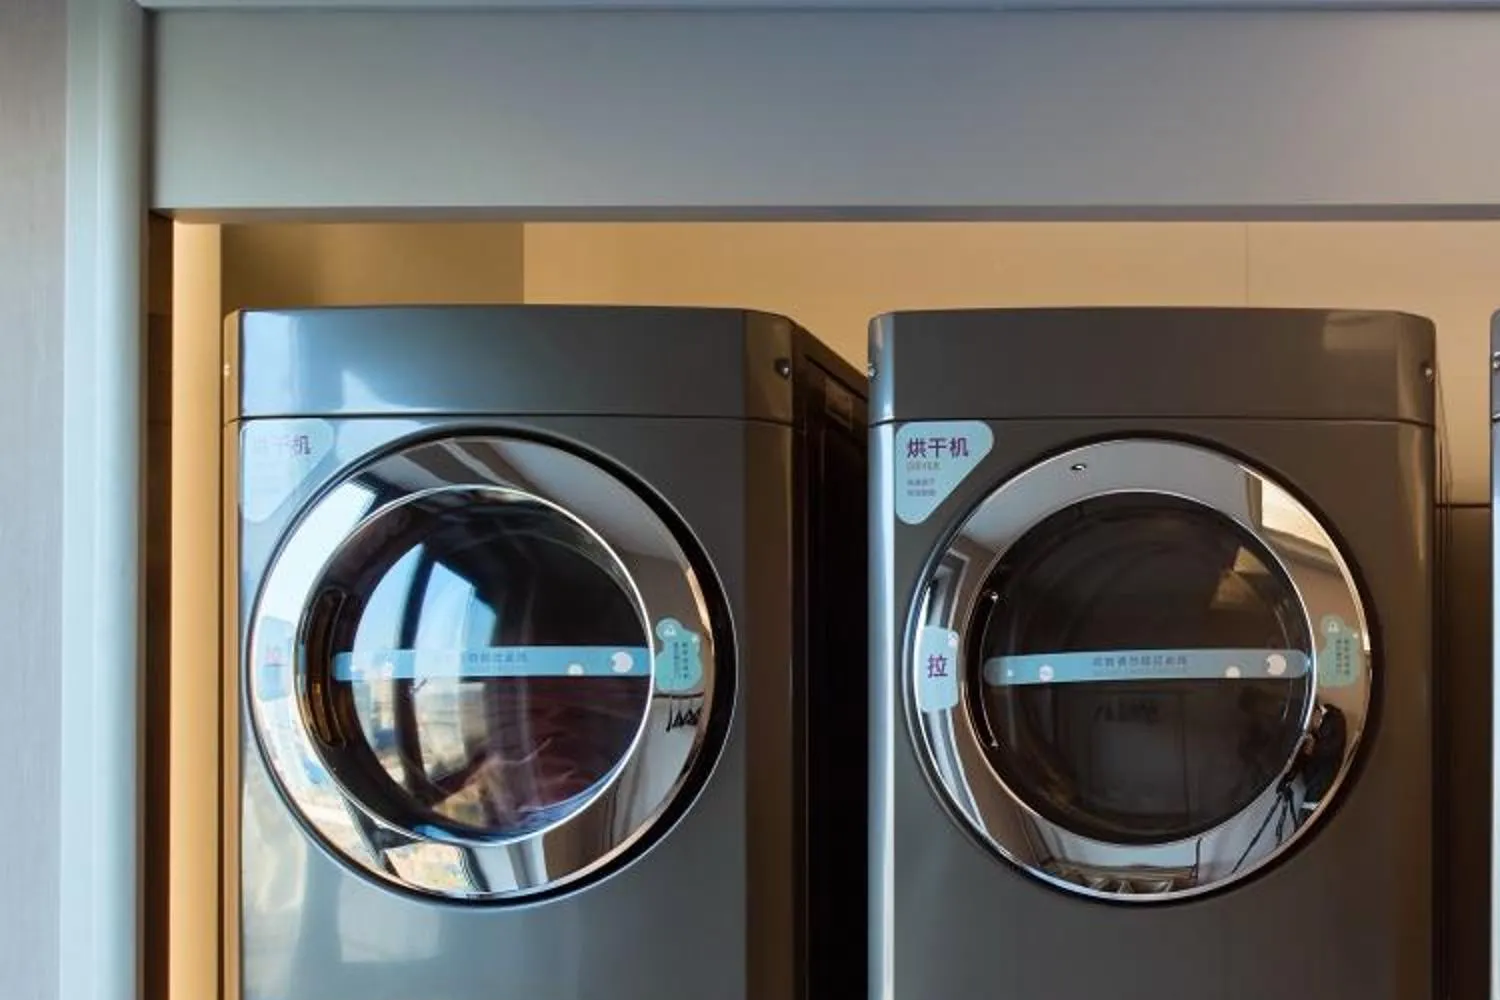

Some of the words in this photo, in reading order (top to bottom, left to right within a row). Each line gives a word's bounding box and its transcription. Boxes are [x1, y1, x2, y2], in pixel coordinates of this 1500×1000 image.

[906, 436, 969, 459] 烘干机
[928, 654, 948, 679] 拉
